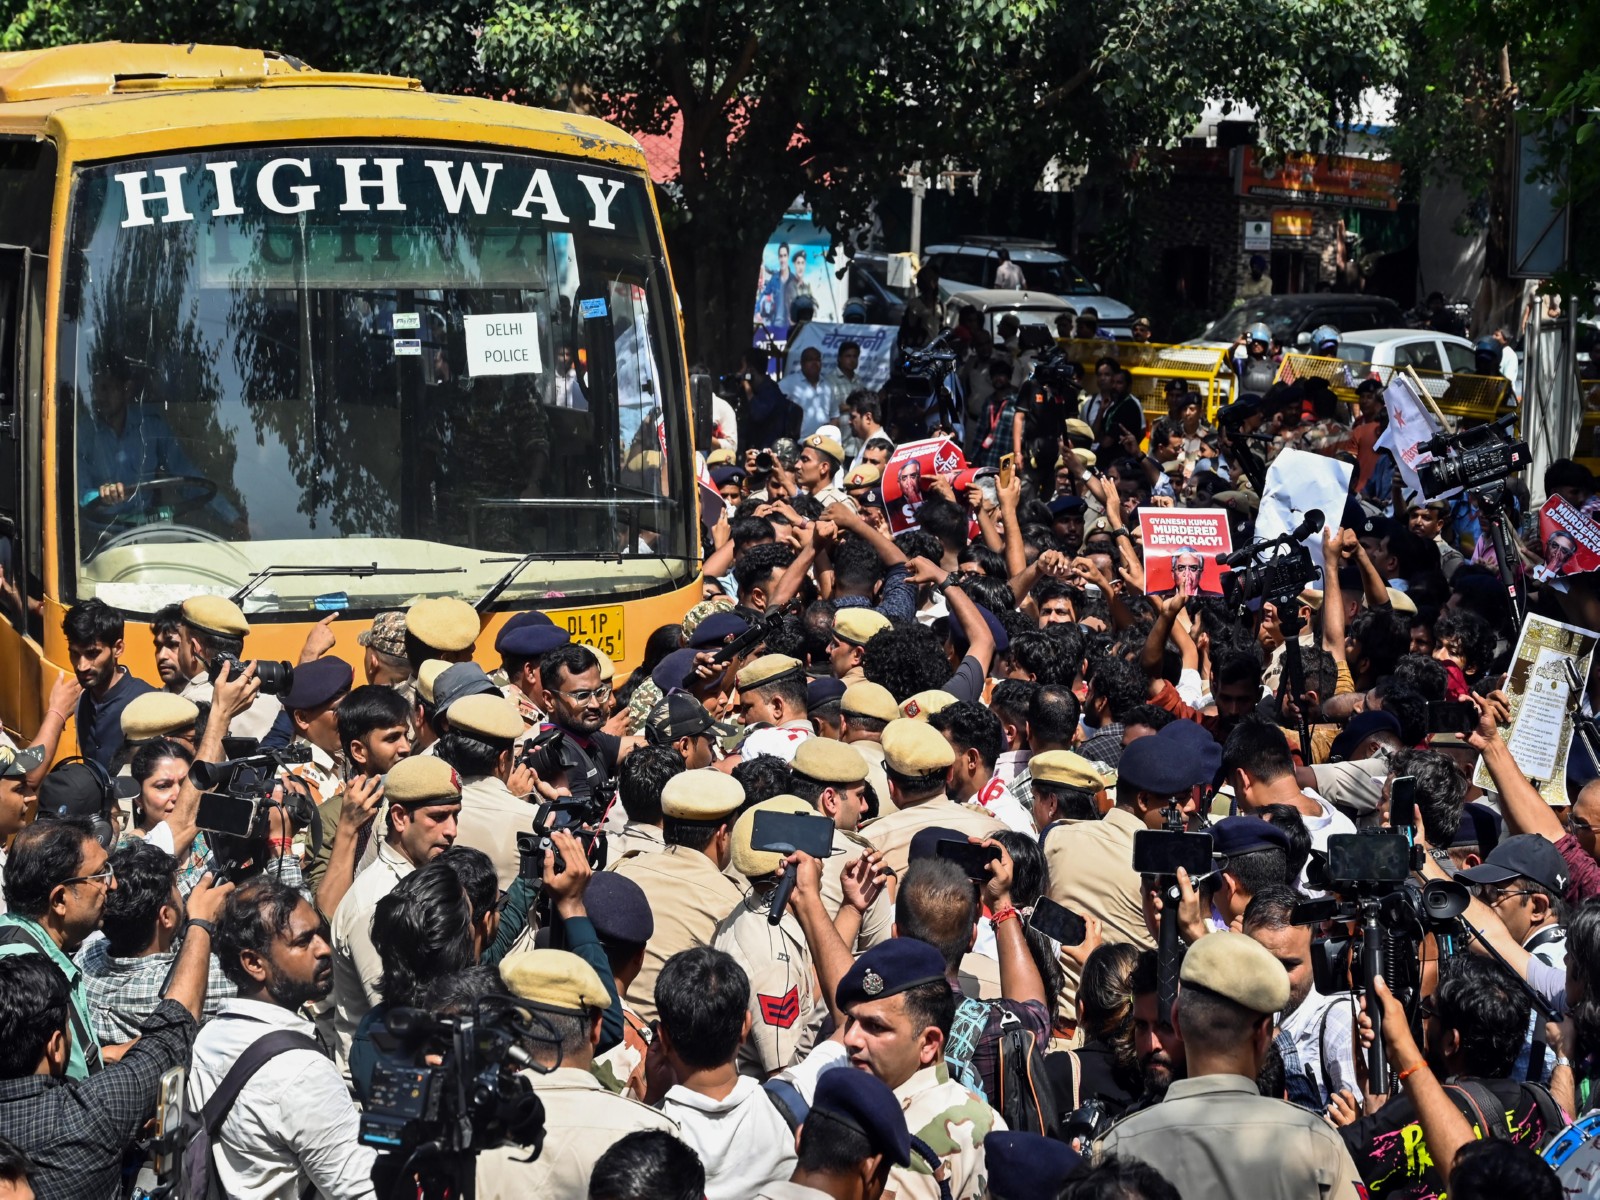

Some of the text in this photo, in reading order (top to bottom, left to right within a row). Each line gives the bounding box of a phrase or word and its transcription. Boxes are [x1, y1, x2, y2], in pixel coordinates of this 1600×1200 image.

[114, 157, 625, 230] HIGHWAY
[486, 322, 522, 337] DELHI
[485, 349, 529, 363] POLICE
[1149, 517, 1218, 526] GYANESH KUMAR
[1152, 525, 1218, 536] MURDERED
[1150, 534, 1223, 546] DEMOCRACY!
